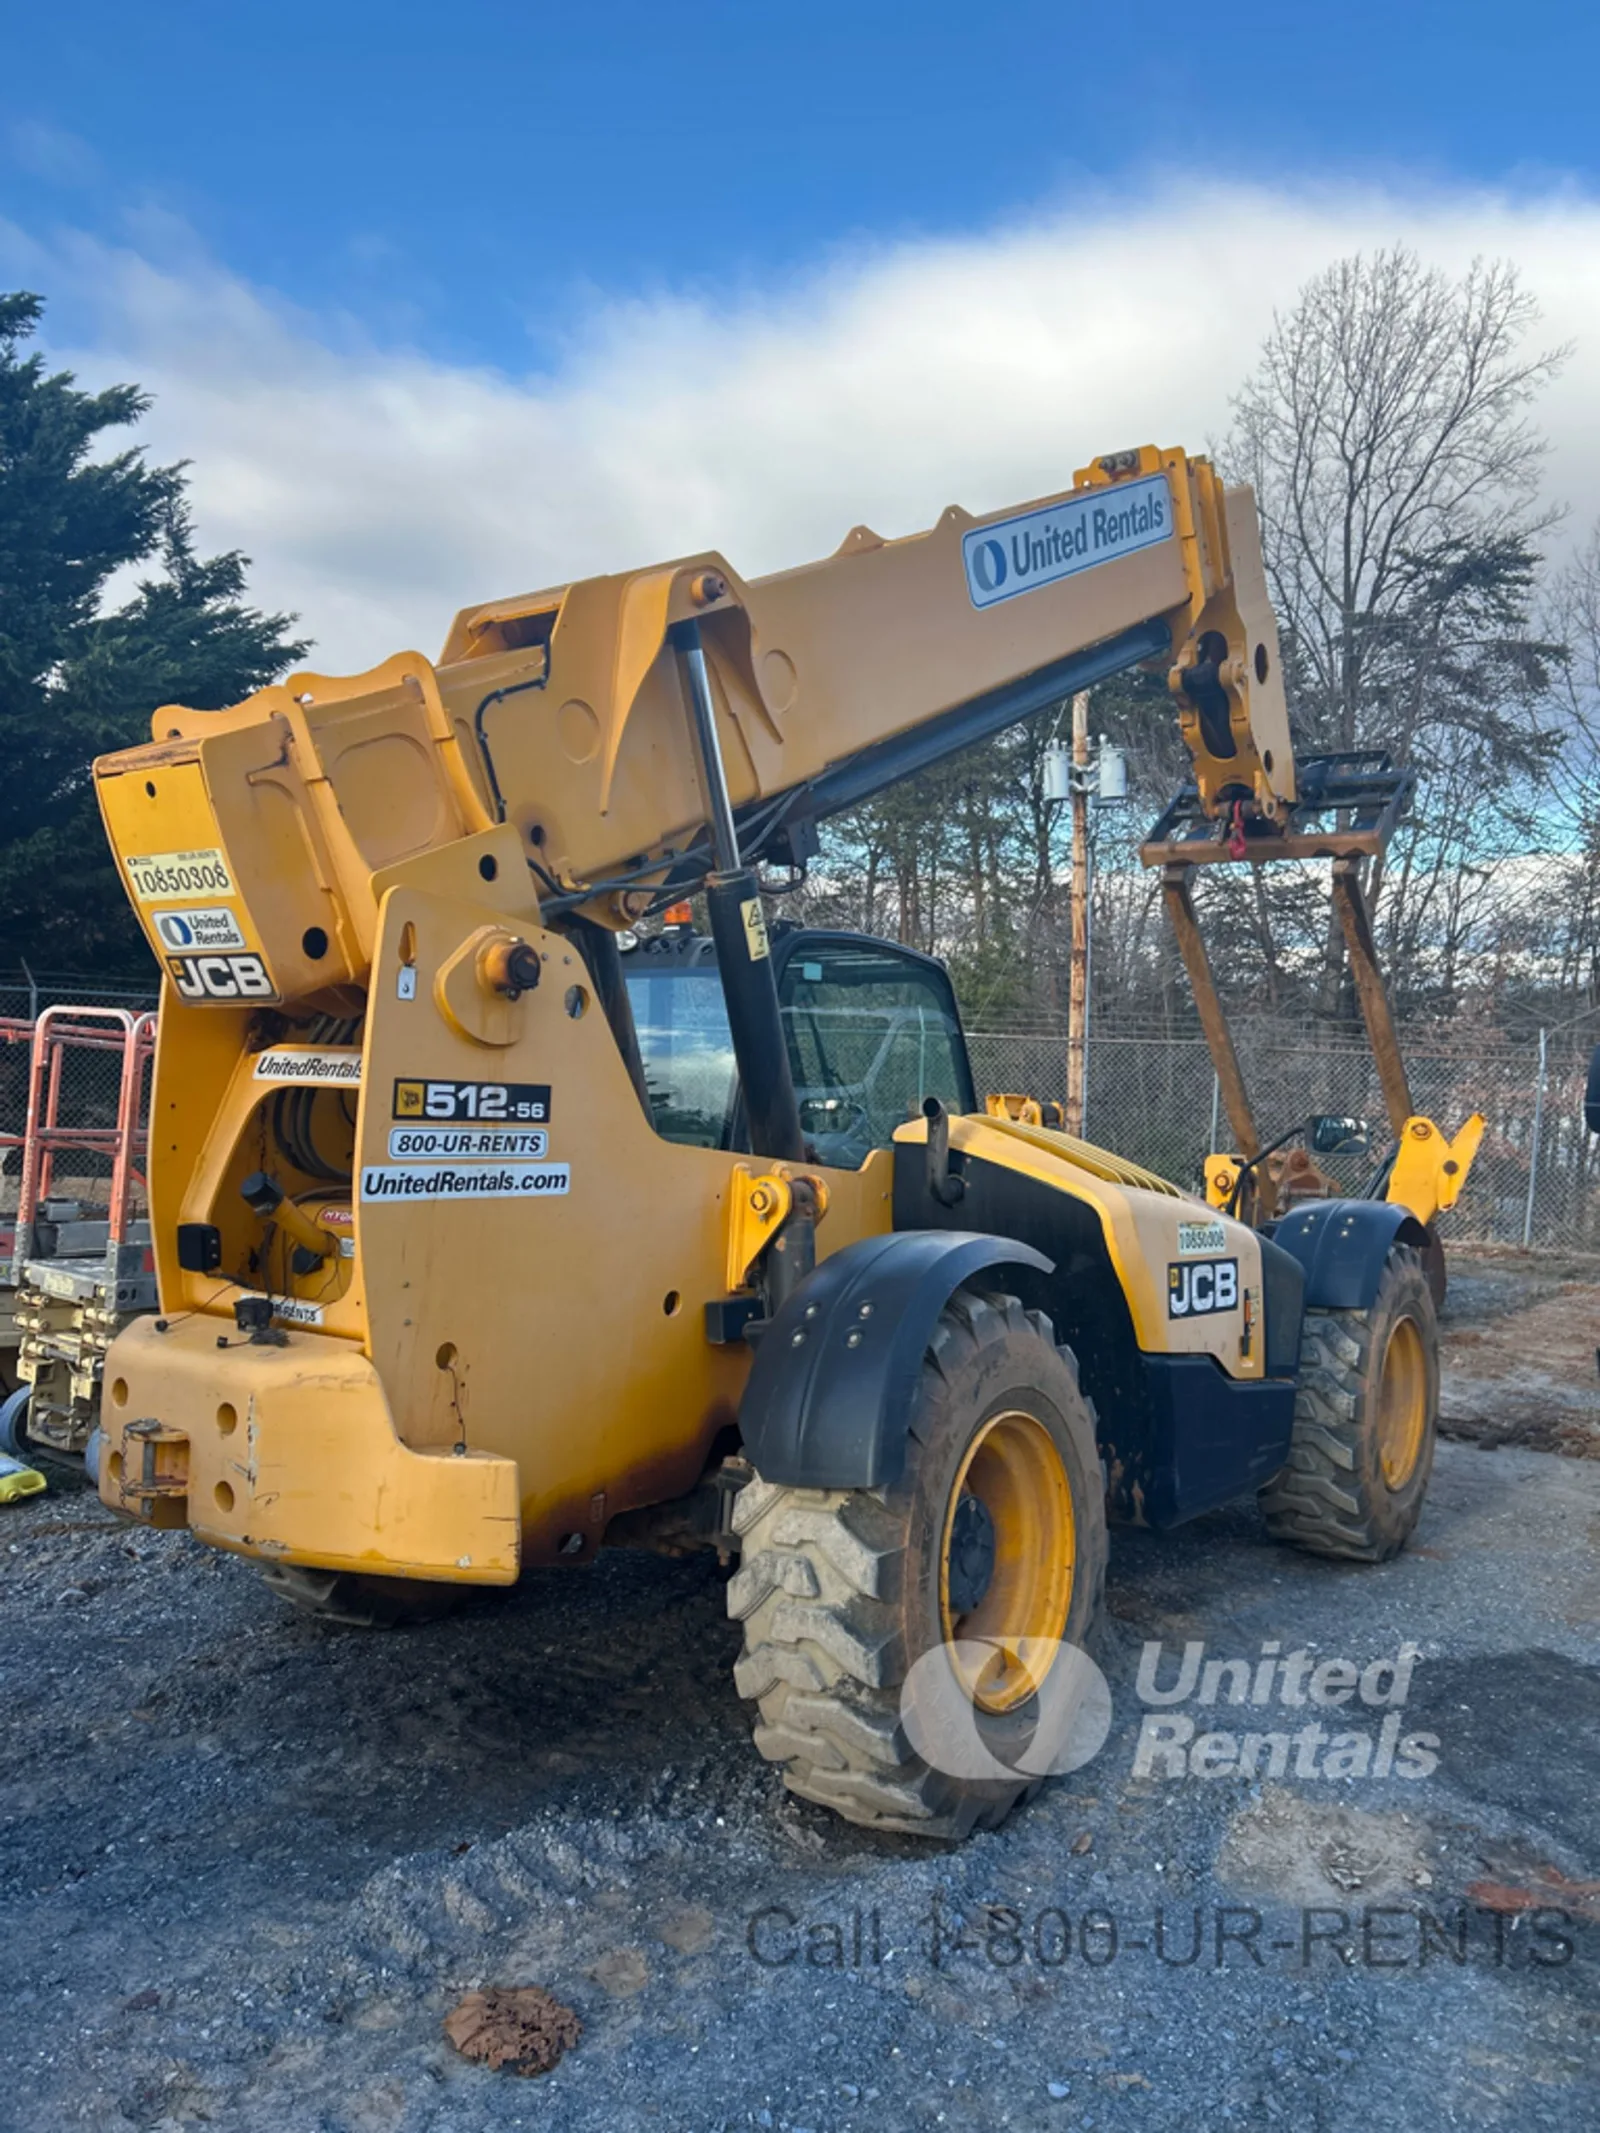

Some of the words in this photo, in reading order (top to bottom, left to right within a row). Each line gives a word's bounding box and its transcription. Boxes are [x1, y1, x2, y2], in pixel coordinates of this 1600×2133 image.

[1011, 512, 1087, 576] United
[1092, 492, 1164, 549] Rentals
[133, 860, 229, 894] 10850308
[188, 914, 228, 930] United
[195, 931, 239, 945] Rentals
[177, 957, 272, 997] JCB
[397, 1135, 541, 1152] 800-UR-RENTS
[365, 1170, 567, 1195] UnitedRentals.com
[1170, 1263, 1236, 1314] JCB
